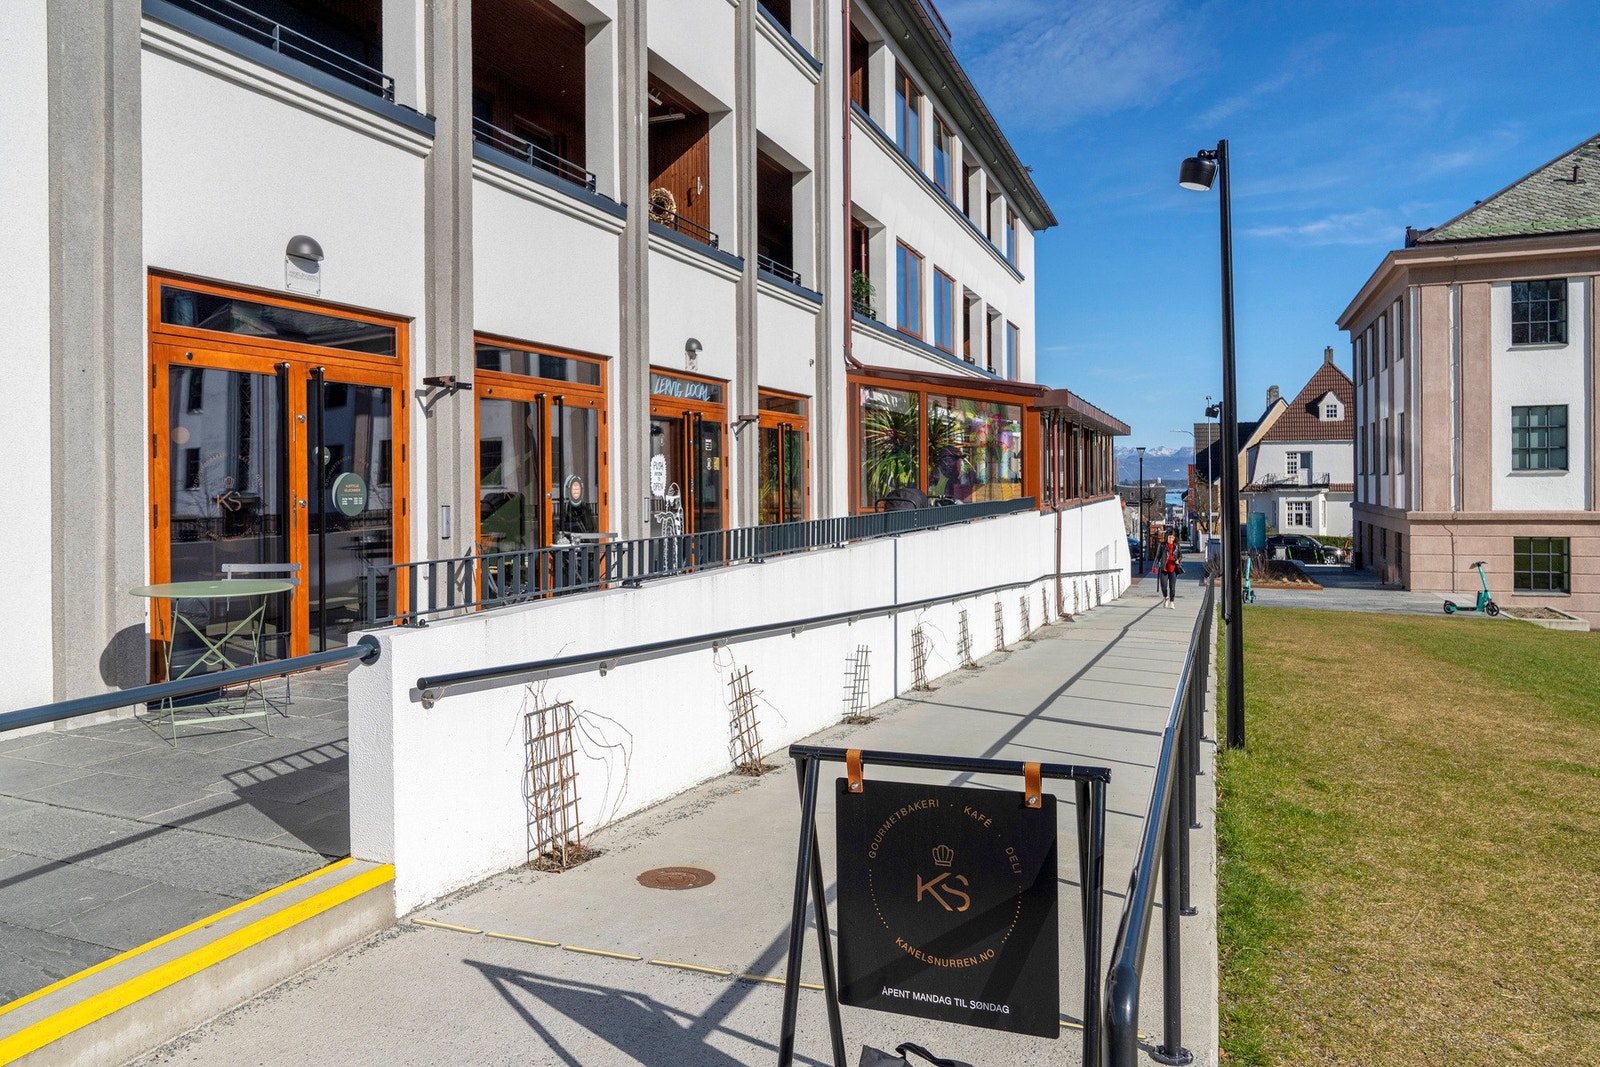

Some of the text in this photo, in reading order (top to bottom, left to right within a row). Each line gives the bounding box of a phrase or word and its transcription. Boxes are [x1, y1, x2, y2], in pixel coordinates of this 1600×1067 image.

[685, 383, 711, 402] LOCAL
[216, 491, 242, 512] KS
[868, 799, 1023, 875] GOURMETBAKERI KAFÉ DELI
[916, 872, 971, 912] KS
[895, 936, 996, 968] KANELSNURREN.NO
[881, 985, 1010, 1015] ÅPENT MANDAG TIL SØNDAG
